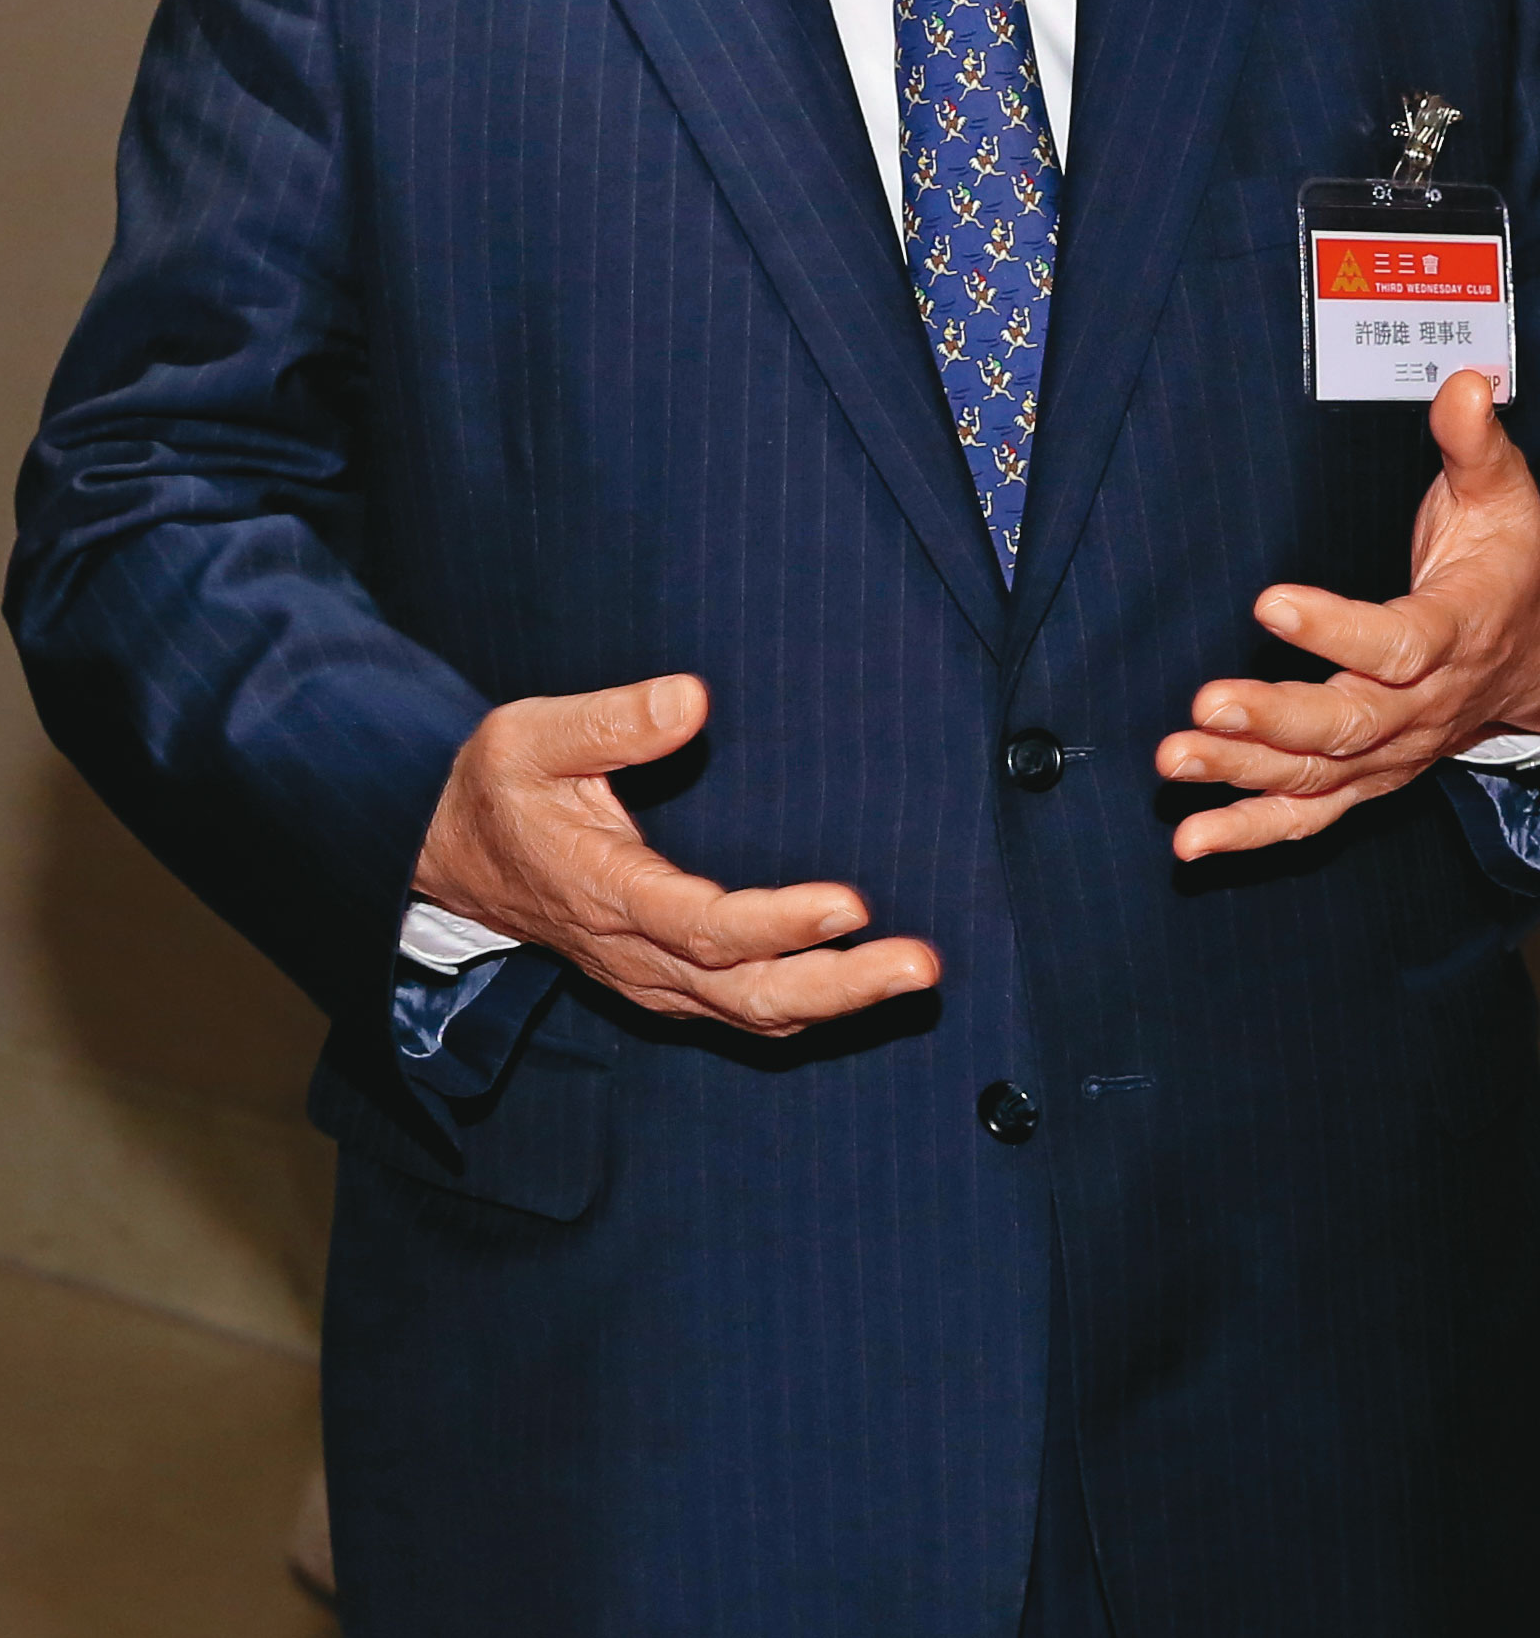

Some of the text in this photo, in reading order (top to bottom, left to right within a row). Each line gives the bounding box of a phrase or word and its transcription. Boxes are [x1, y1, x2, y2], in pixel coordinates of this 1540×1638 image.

[1374, 253, 1439, 275] 三三會
[1375, 283, 1492, 295] THIRD WEDNESDAY CLUB
[1355, 321, 1473, 345] 許勝雄 理事長
[1395, 362, 1439, 383] 三三會
